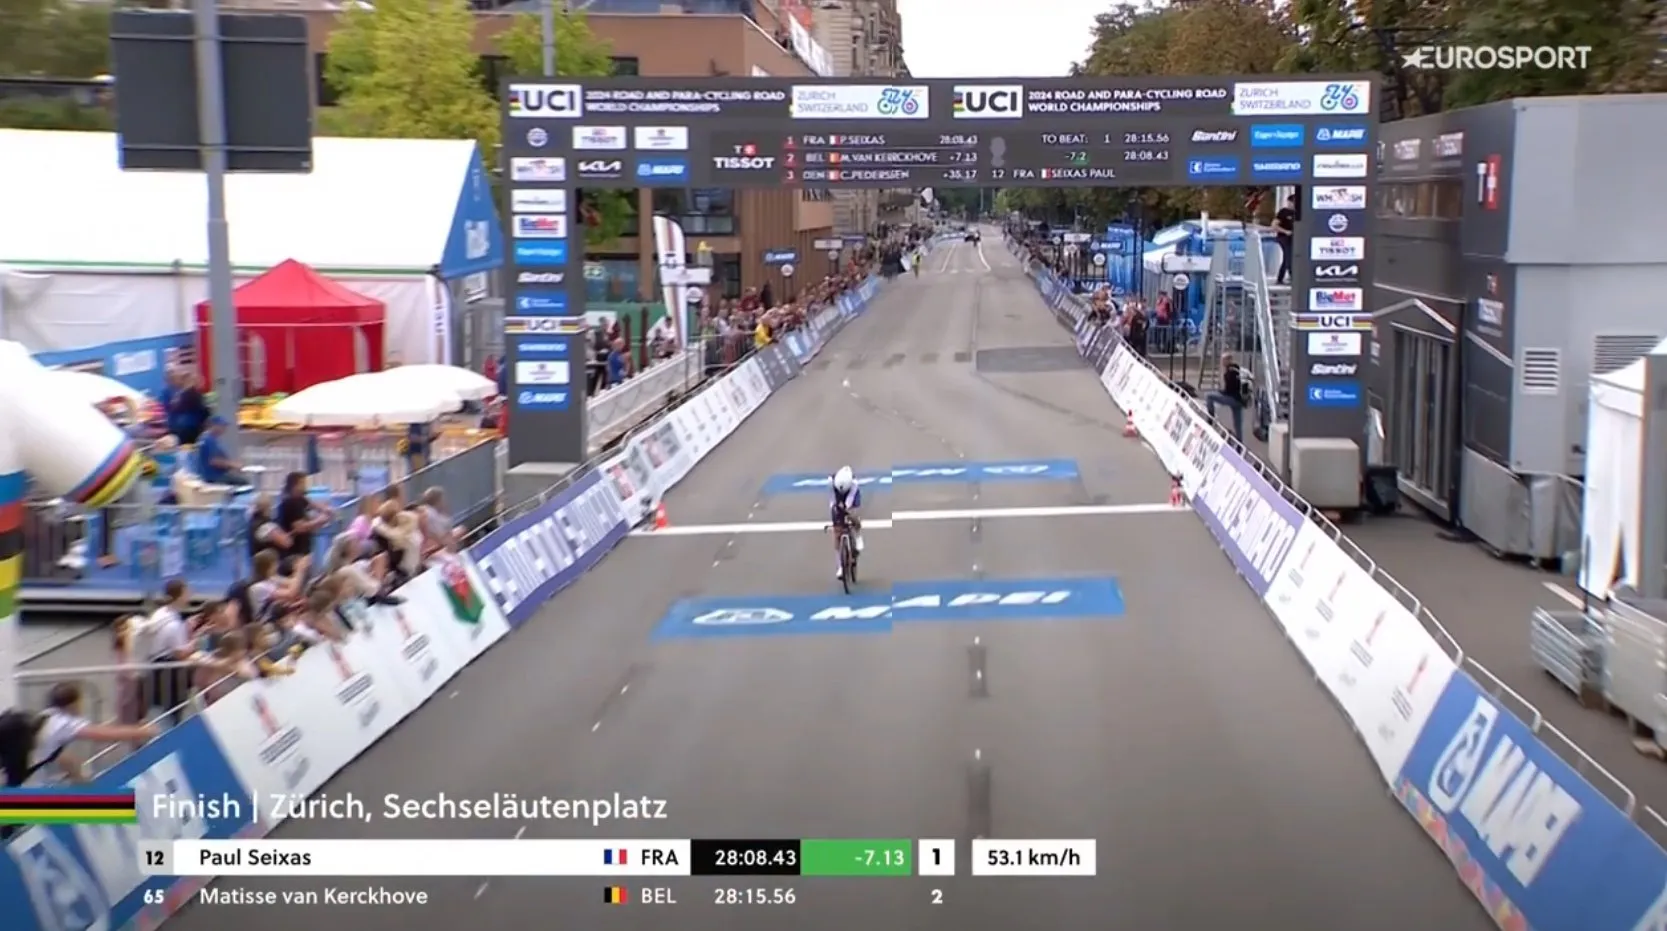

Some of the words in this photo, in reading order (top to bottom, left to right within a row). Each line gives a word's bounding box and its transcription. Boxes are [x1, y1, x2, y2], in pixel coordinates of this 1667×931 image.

[586, 91, 611, 99] 2024
[613, 91, 644, 99] ROAD
[646, 91, 671, 99] AND
[673, 91, 751, 99] PARA-CYCLING
[754, 91, 785, 99] ROAD
[1029, 91, 1053, 100] 2024
[1055, 90, 1086, 99] ROAD
[1088, 90, 1112, 99] AND
[1114, 89, 1193, 99] PARA-CYCLING
[1195, 89, 1227, 98] ROAD
[1240, 88, 1278, 97] ZURICH
[524, 90, 575, 111] UCI
[966, 91, 1018, 112] UCI
[1240, 100, 1311, 109] SWITZERLAND
[586, 103, 627, 112] WORLD
[629, 103, 720, 112] CHAMPIONSHIPS
[797, 103, 869, 113] SWITZERLAND
[1029, 103, 1068, 112] WORLD
[1070, 101, 1161, 112] CHAMPIONSHIPS
[803, 135, 825, 144] FRA
[1042, 134, 1057, 143] TO
[1059, 134, 1088, 143] BEAT:
[1124, 133, 1170, 143] 28:15.56
[1124, 152, 1169, 161] 28:08.43
[713, 157, 775, 169] TISSOT
[1013, 169, 1035, 178] FRA
[1052, 169, 1086, 178] SEIXAS
[1089, 169, 1116, 178] PAUL
[1321, 316, 1350, 327] UCI
[810, 591, 1071, 620] MAPEI
